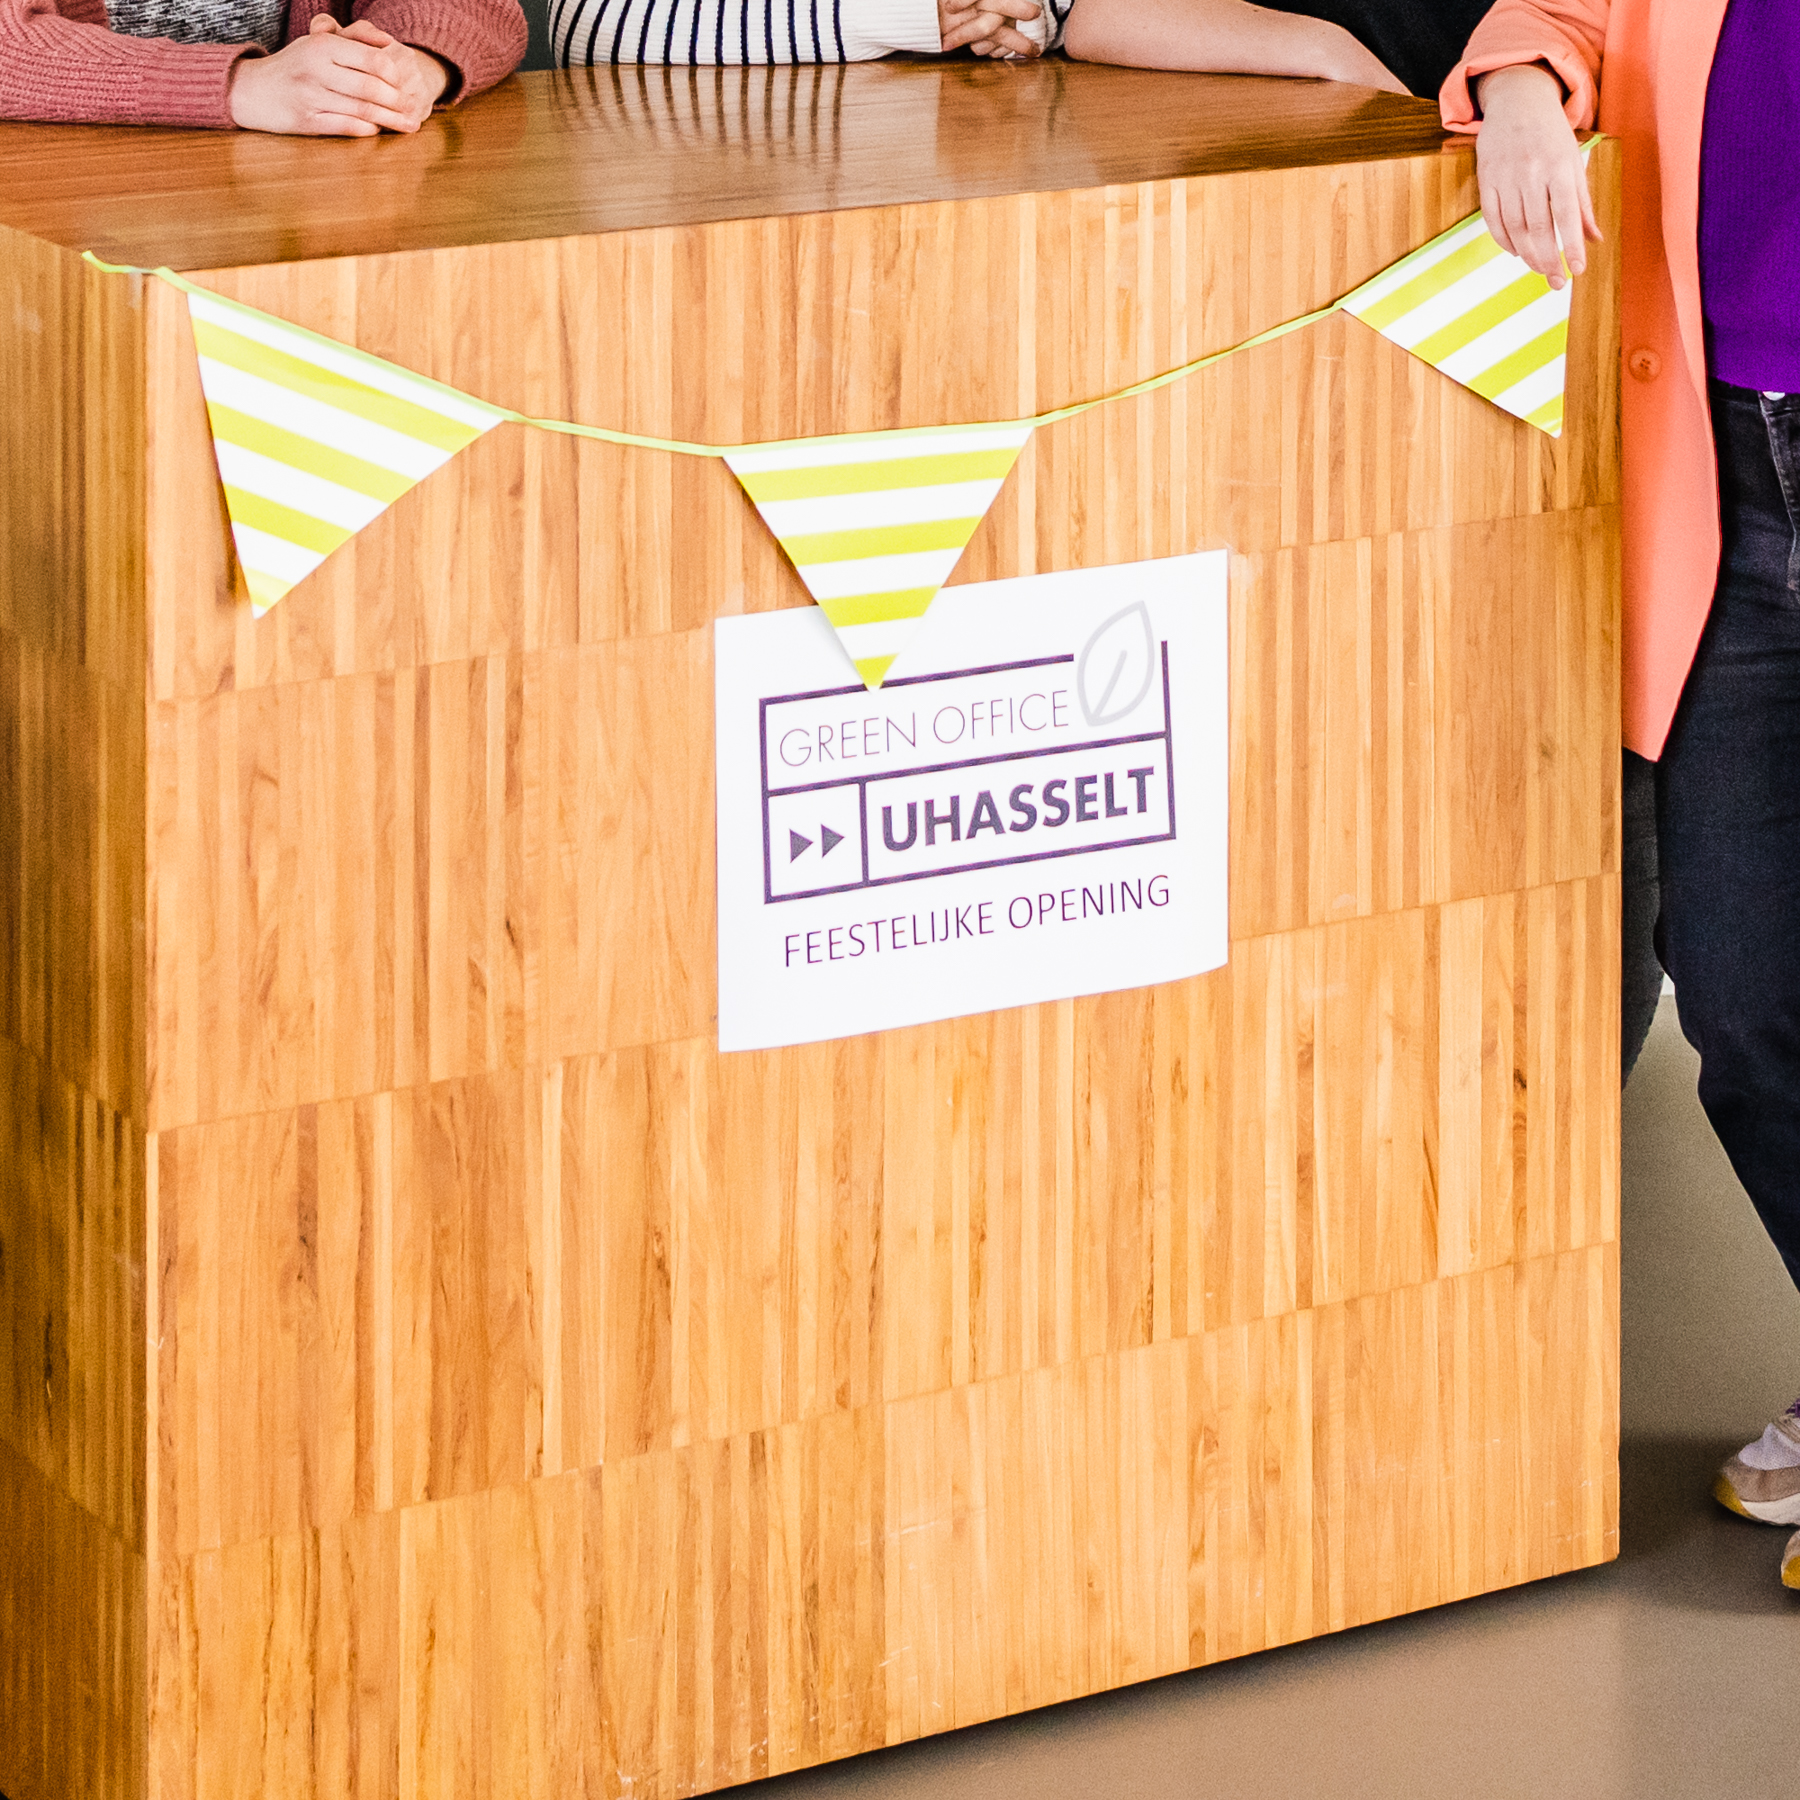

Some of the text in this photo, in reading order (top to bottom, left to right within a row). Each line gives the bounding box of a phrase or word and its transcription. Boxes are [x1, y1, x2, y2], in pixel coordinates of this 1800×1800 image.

[779, 689, 1070, 767] GREEN OFFICE
[881, 767, 1155, 852] UHASSELT
[784, 875, 1171, 968] FEESTELIJKE OPENING
